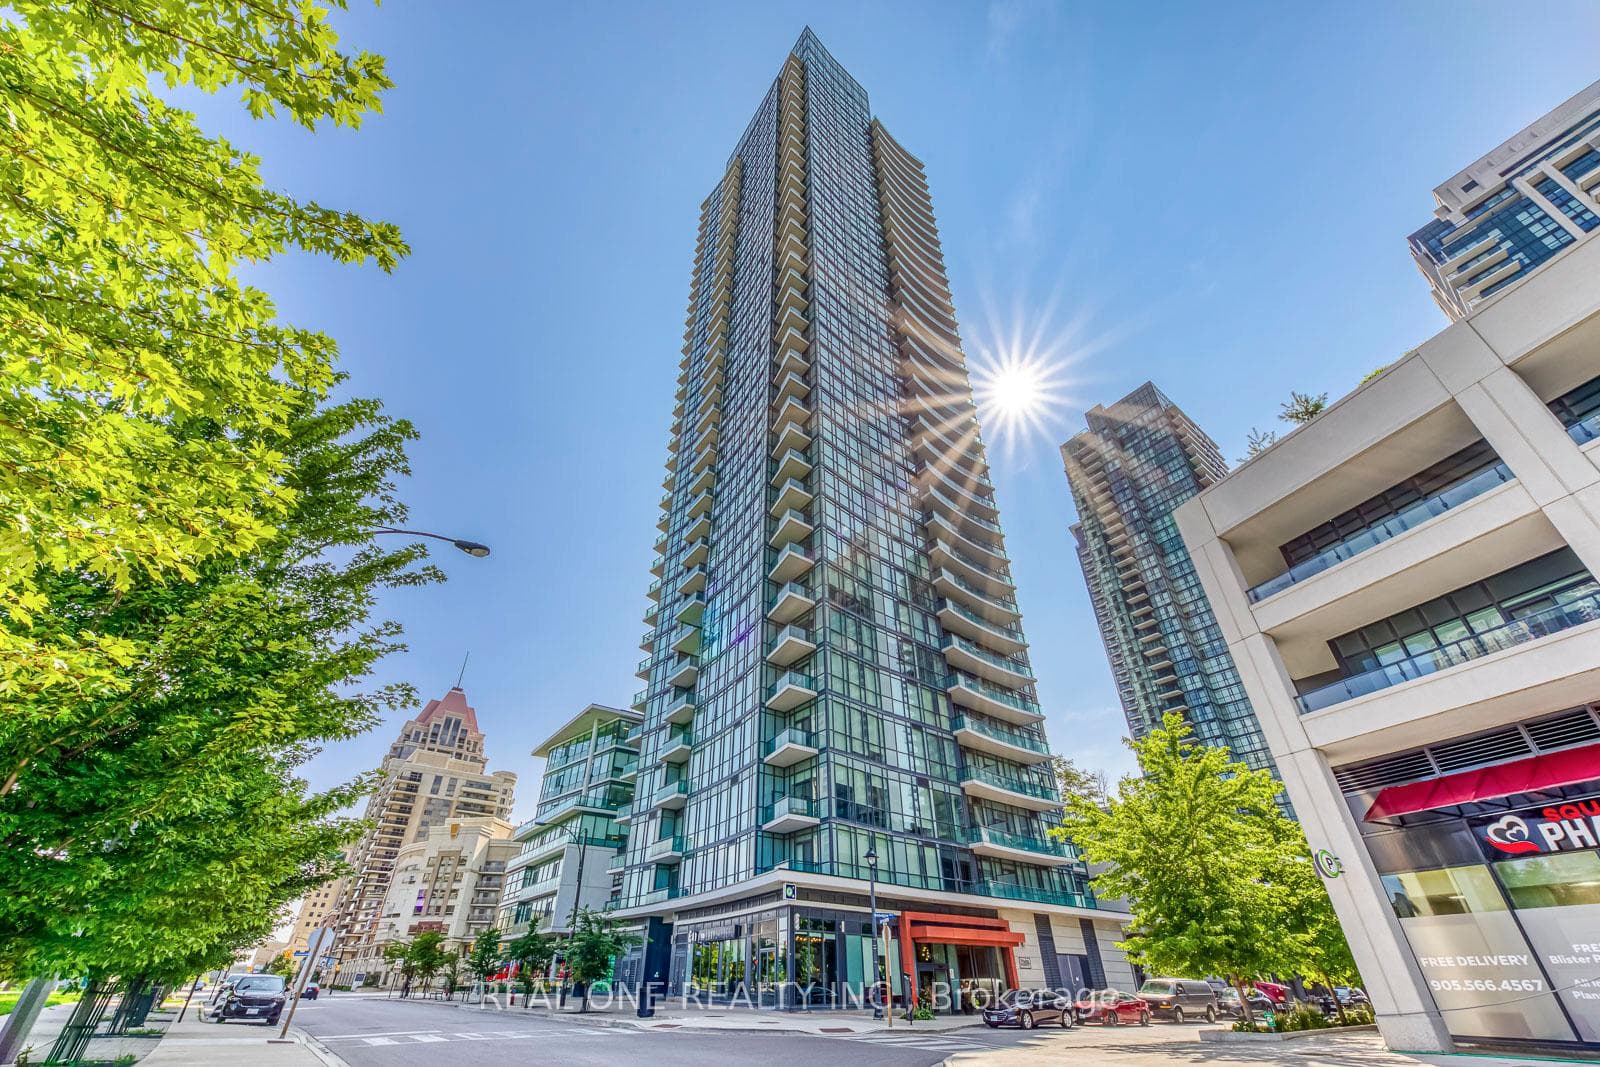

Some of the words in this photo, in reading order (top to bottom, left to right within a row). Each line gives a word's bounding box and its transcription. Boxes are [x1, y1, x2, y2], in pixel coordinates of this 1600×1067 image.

[1572, 943, 1600, 953] FRE
[1420, 956, 1456, 967] FREE
[1456, 955, 1528, 966] DELIVERY
[1549, 954, 1591, 964] Blister
[1430, 980, 1543, 991] 905.566.4567
